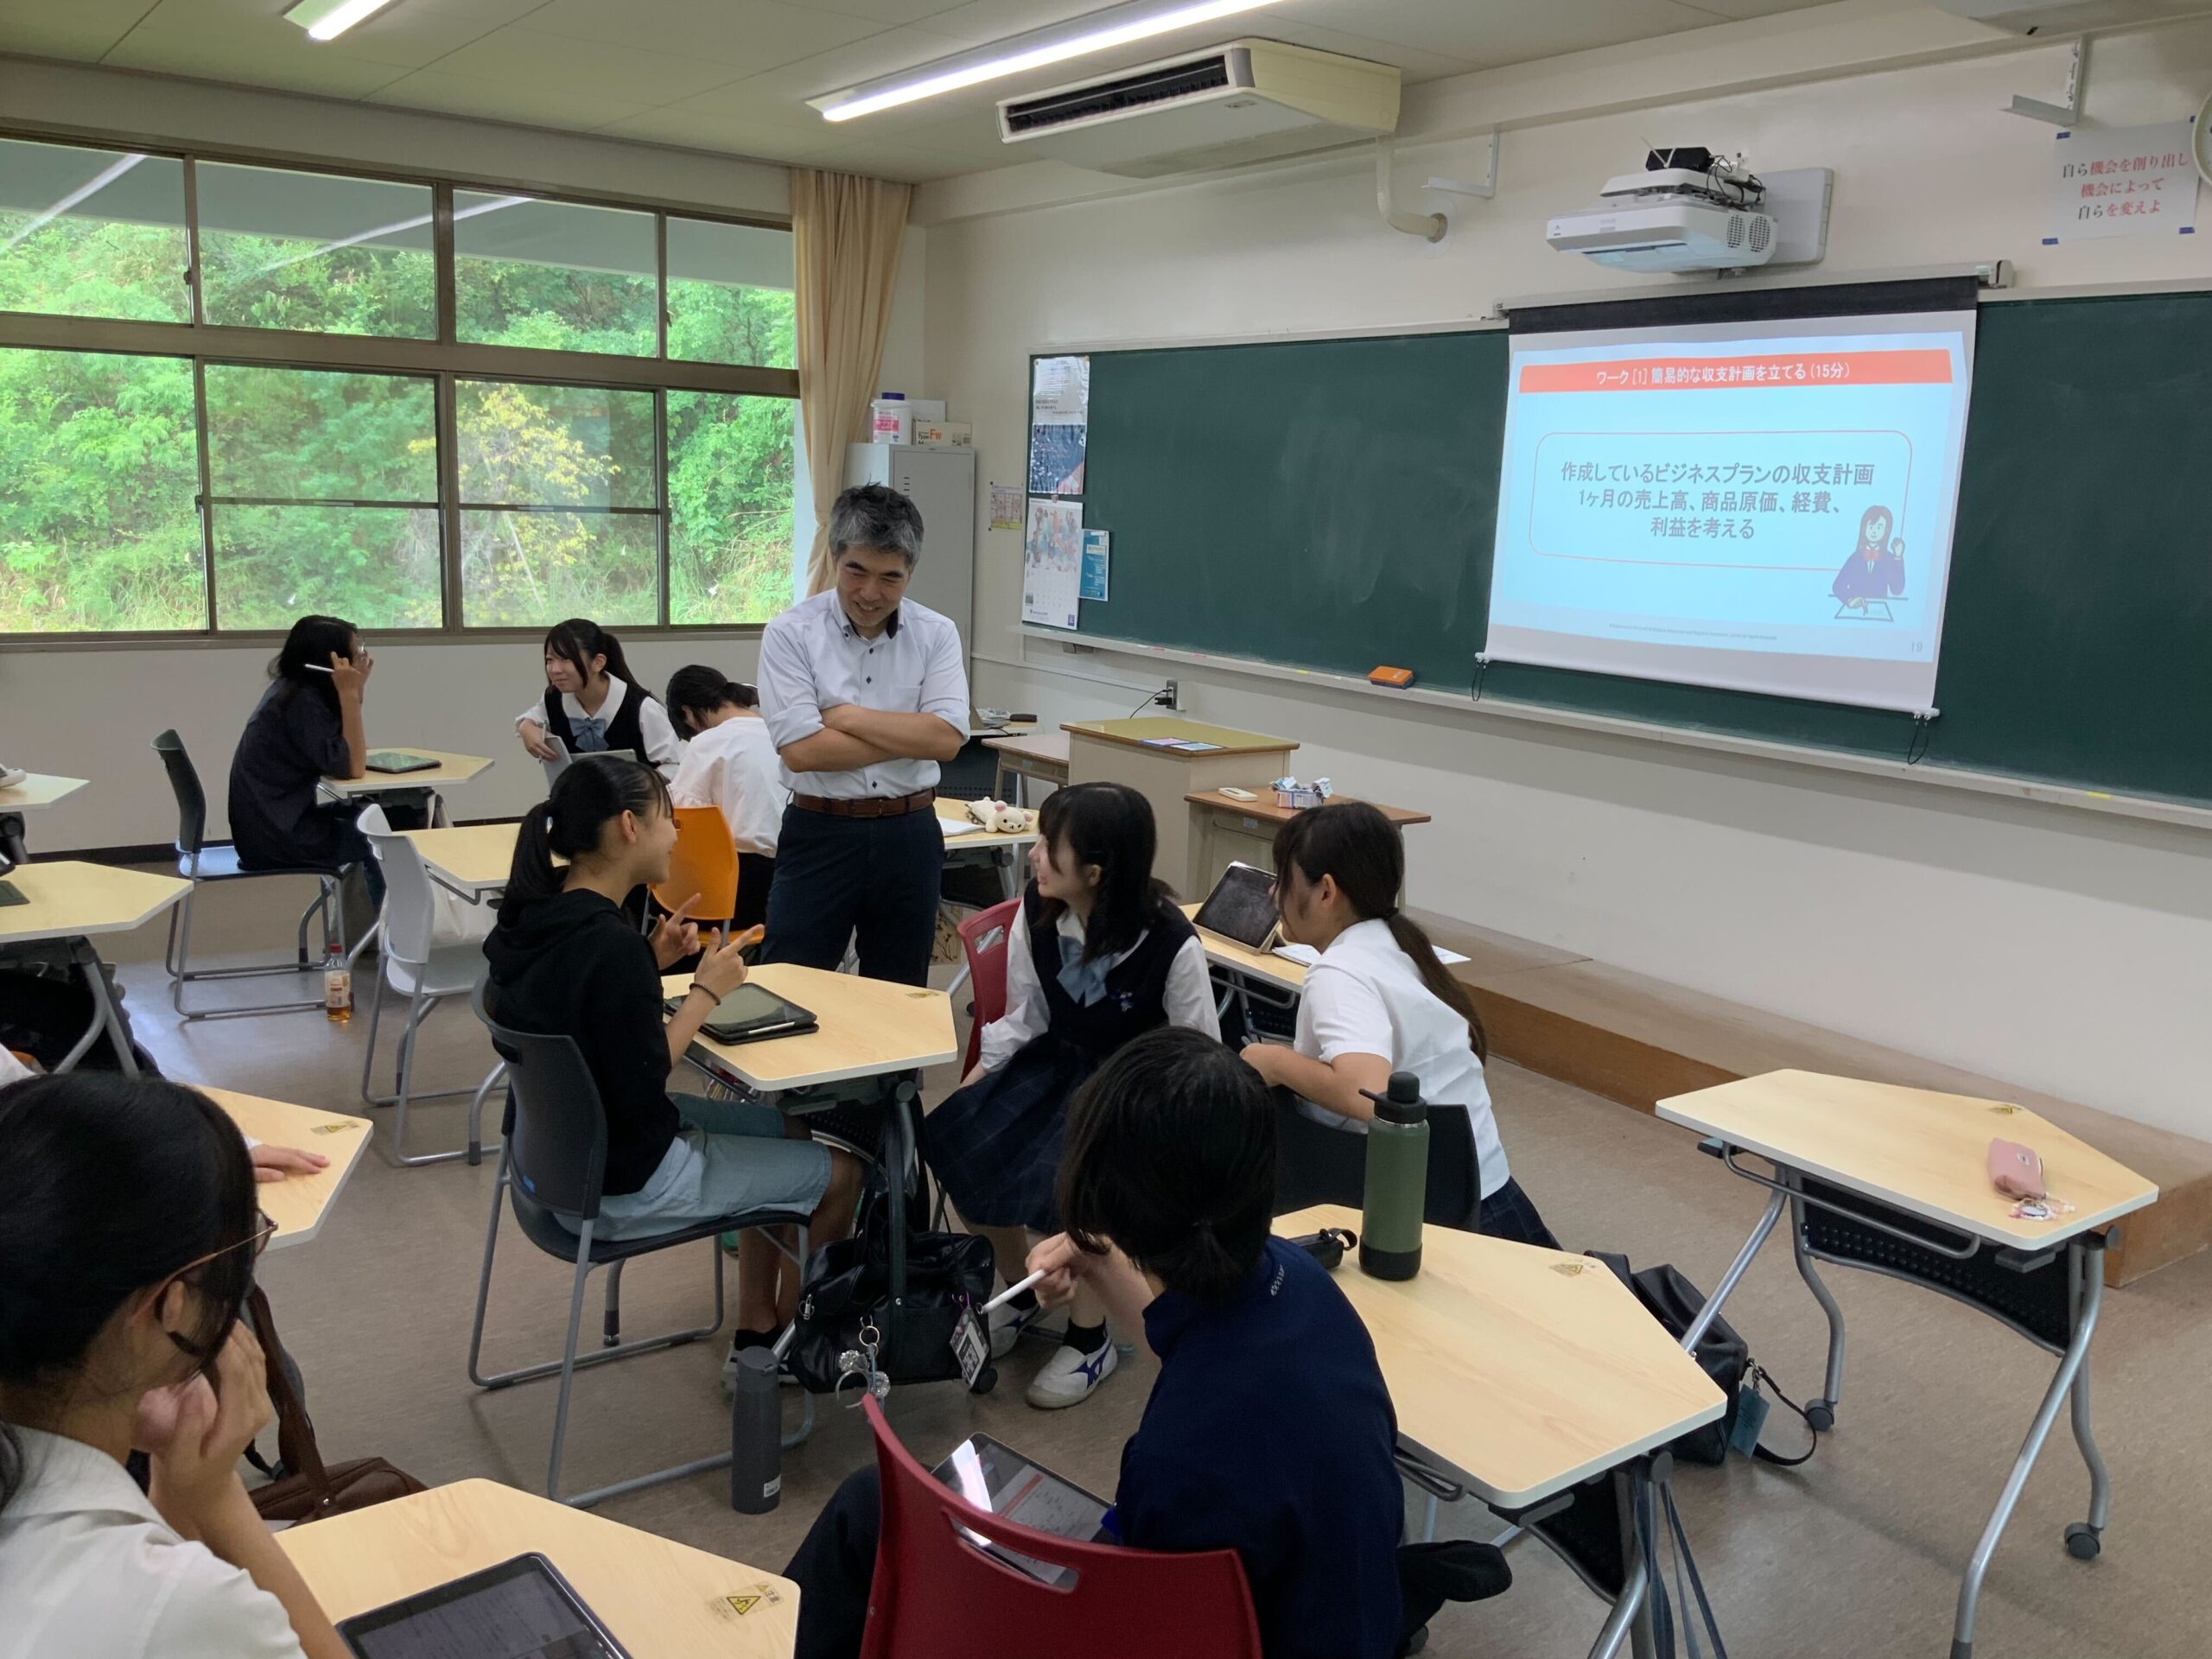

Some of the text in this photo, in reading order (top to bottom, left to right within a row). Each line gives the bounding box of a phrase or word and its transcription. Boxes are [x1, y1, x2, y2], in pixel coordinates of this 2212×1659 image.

[2063, 153, 2189, 178] 自ら機会を創り出し
[2082, 178, 2164, 198] 機会によって
[2078, 200, 2161, 219] 自らを変えよ
[1560, 461, 1876, 486] 作成しているビジネスプランの収支計画
[1650, 517, 1755, 539] 利益を考える
